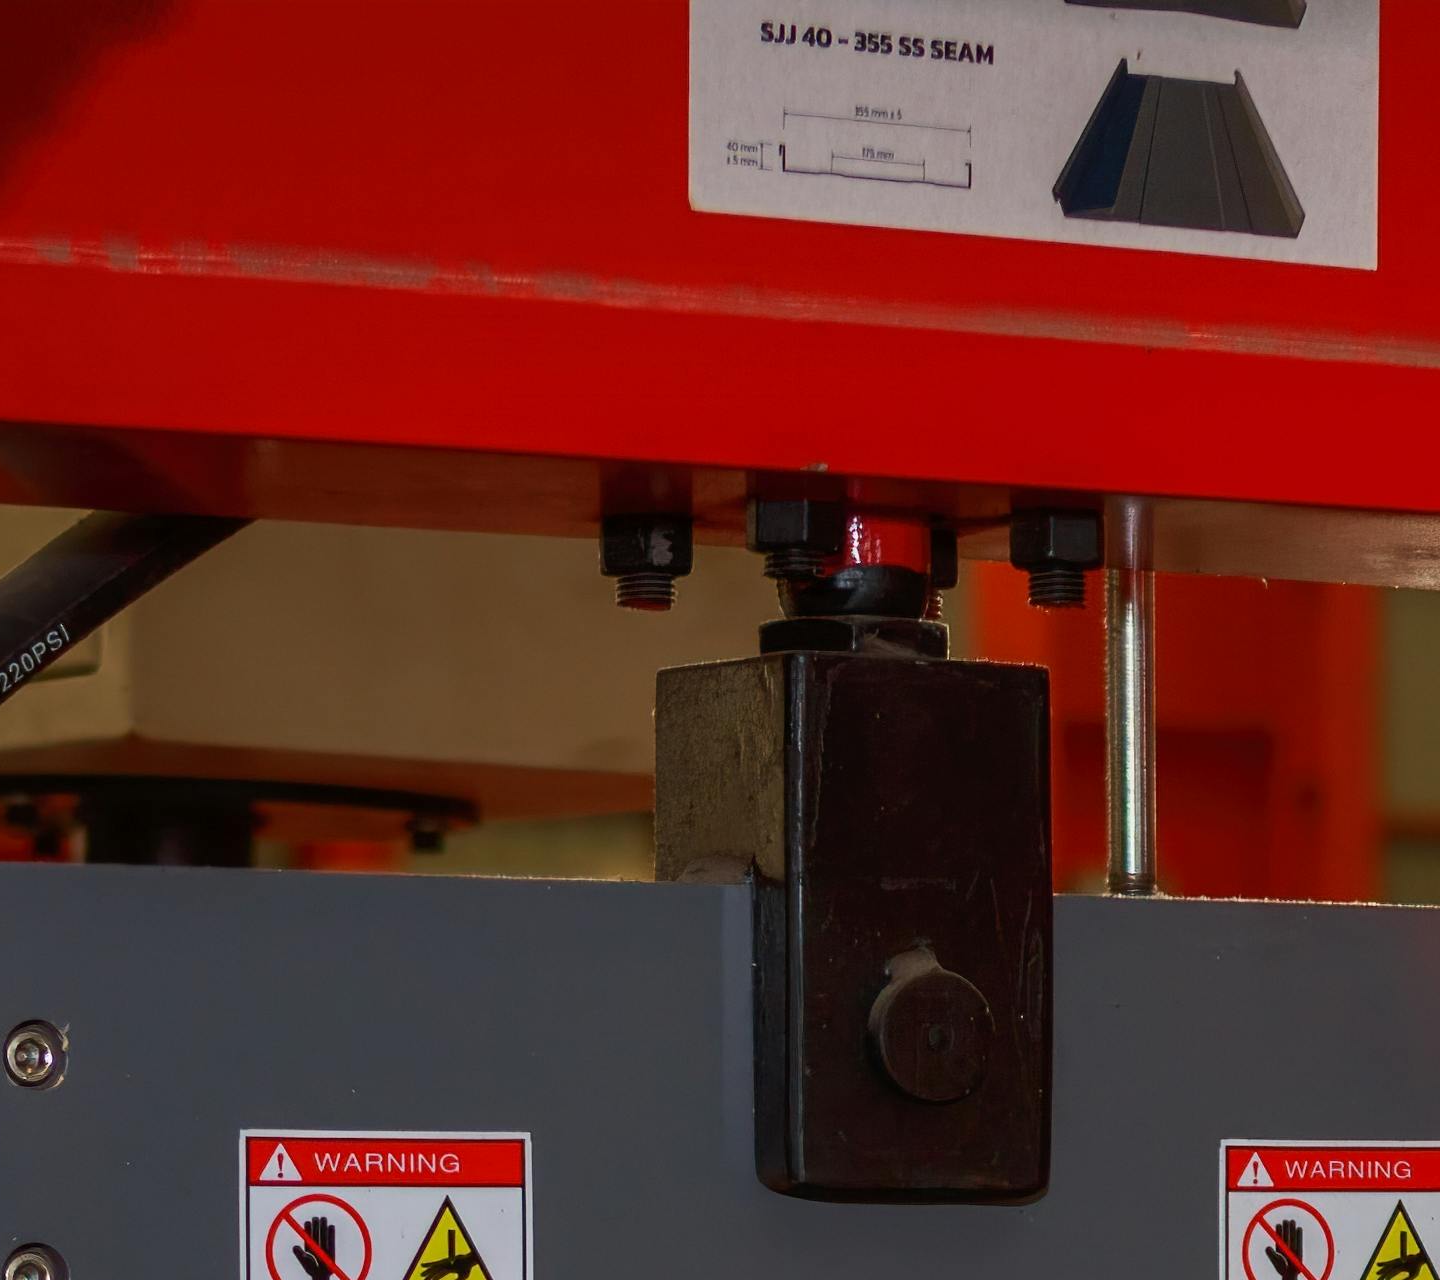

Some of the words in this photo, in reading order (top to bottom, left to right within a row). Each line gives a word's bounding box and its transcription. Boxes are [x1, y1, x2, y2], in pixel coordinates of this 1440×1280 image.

[760, 22, 796, 44] SJJ
[802, 26, 832, 48] 40
[854, 31, 893, 54] 355
[899, 36, 925, 57] SS
[930, 39, 994, 65] SEAM
[314, 1152, 460, 1173] WARNING
[1285, 1160, 1411, 1179] WARNING
